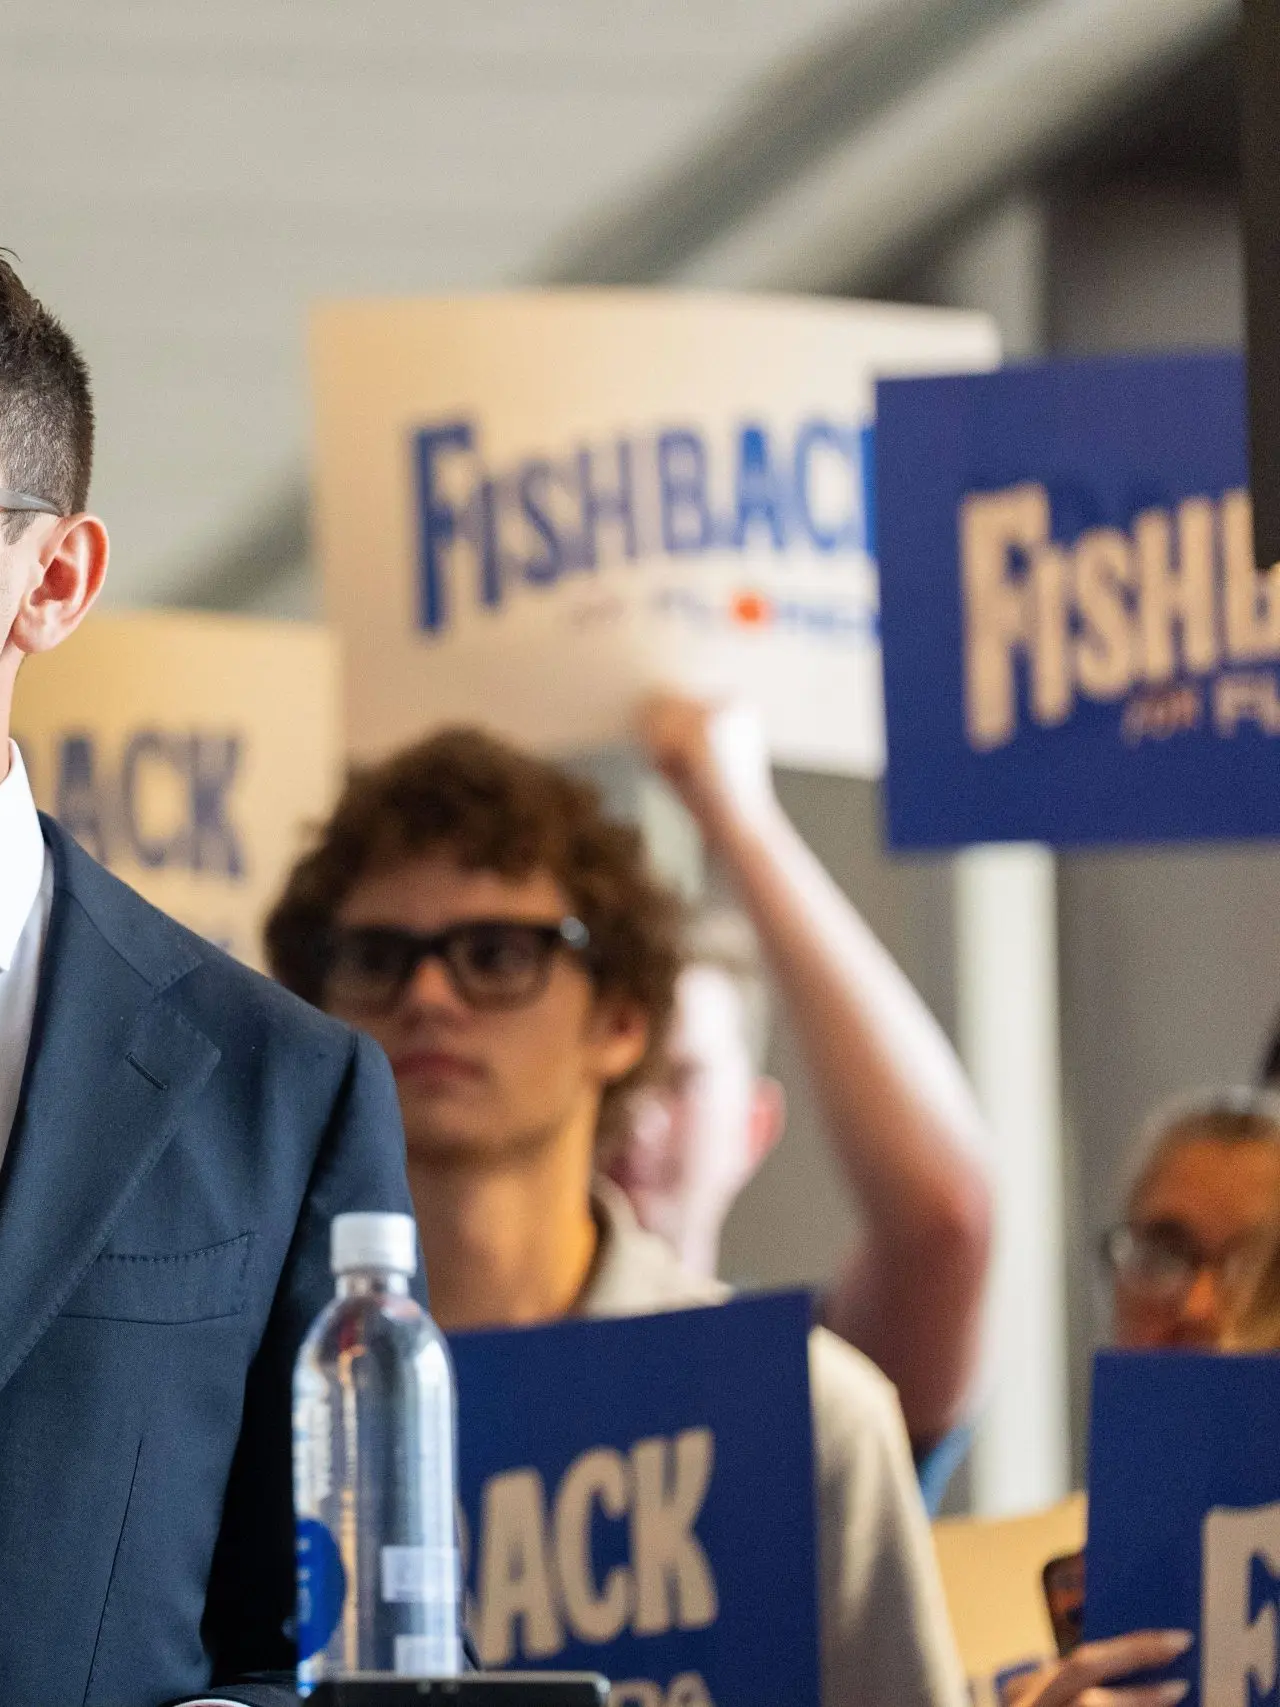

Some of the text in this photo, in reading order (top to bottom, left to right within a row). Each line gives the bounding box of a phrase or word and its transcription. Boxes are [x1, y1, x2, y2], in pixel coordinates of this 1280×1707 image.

[406, 415, 880, 642] FISHBAC
[17, 722, 248, 880] ACK
[460, 1425, 718, 1669] ACK
